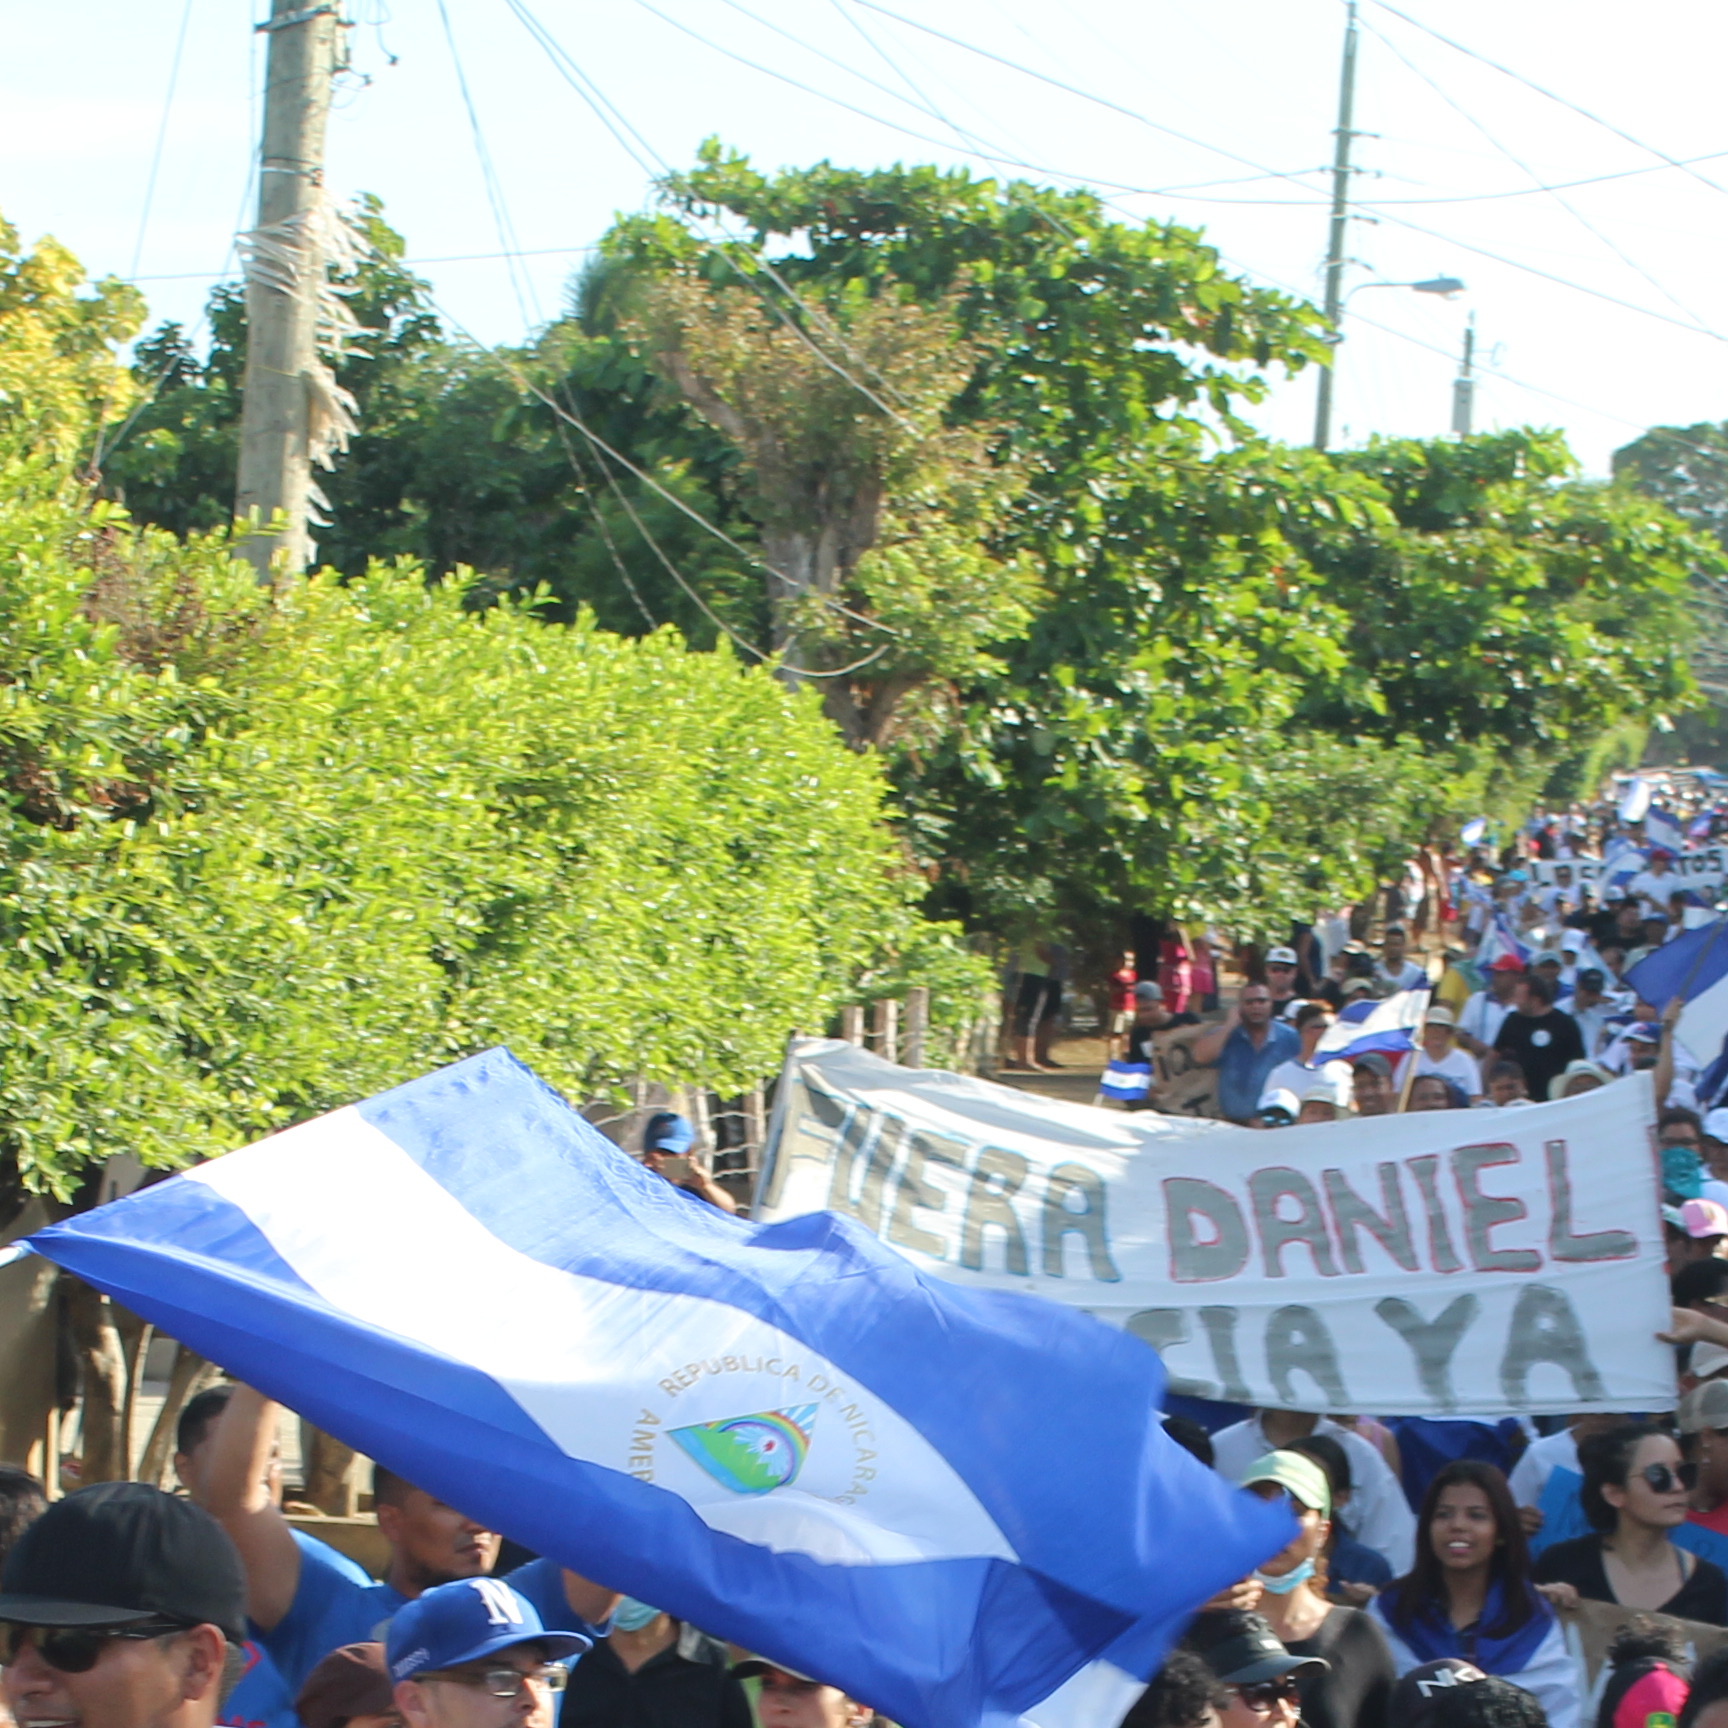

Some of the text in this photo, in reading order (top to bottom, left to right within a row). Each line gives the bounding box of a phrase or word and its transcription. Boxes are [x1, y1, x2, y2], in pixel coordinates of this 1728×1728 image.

[1161, 1138, 1638, 1284] DANIEL
[1373, 1283, 1612, 1412] YA
[629, 1407, 662, 1484] AMER
[657, 1354, 878, 1506] REPUBLICA DE NICARAG
[468, 1579, 524, 1625] N
